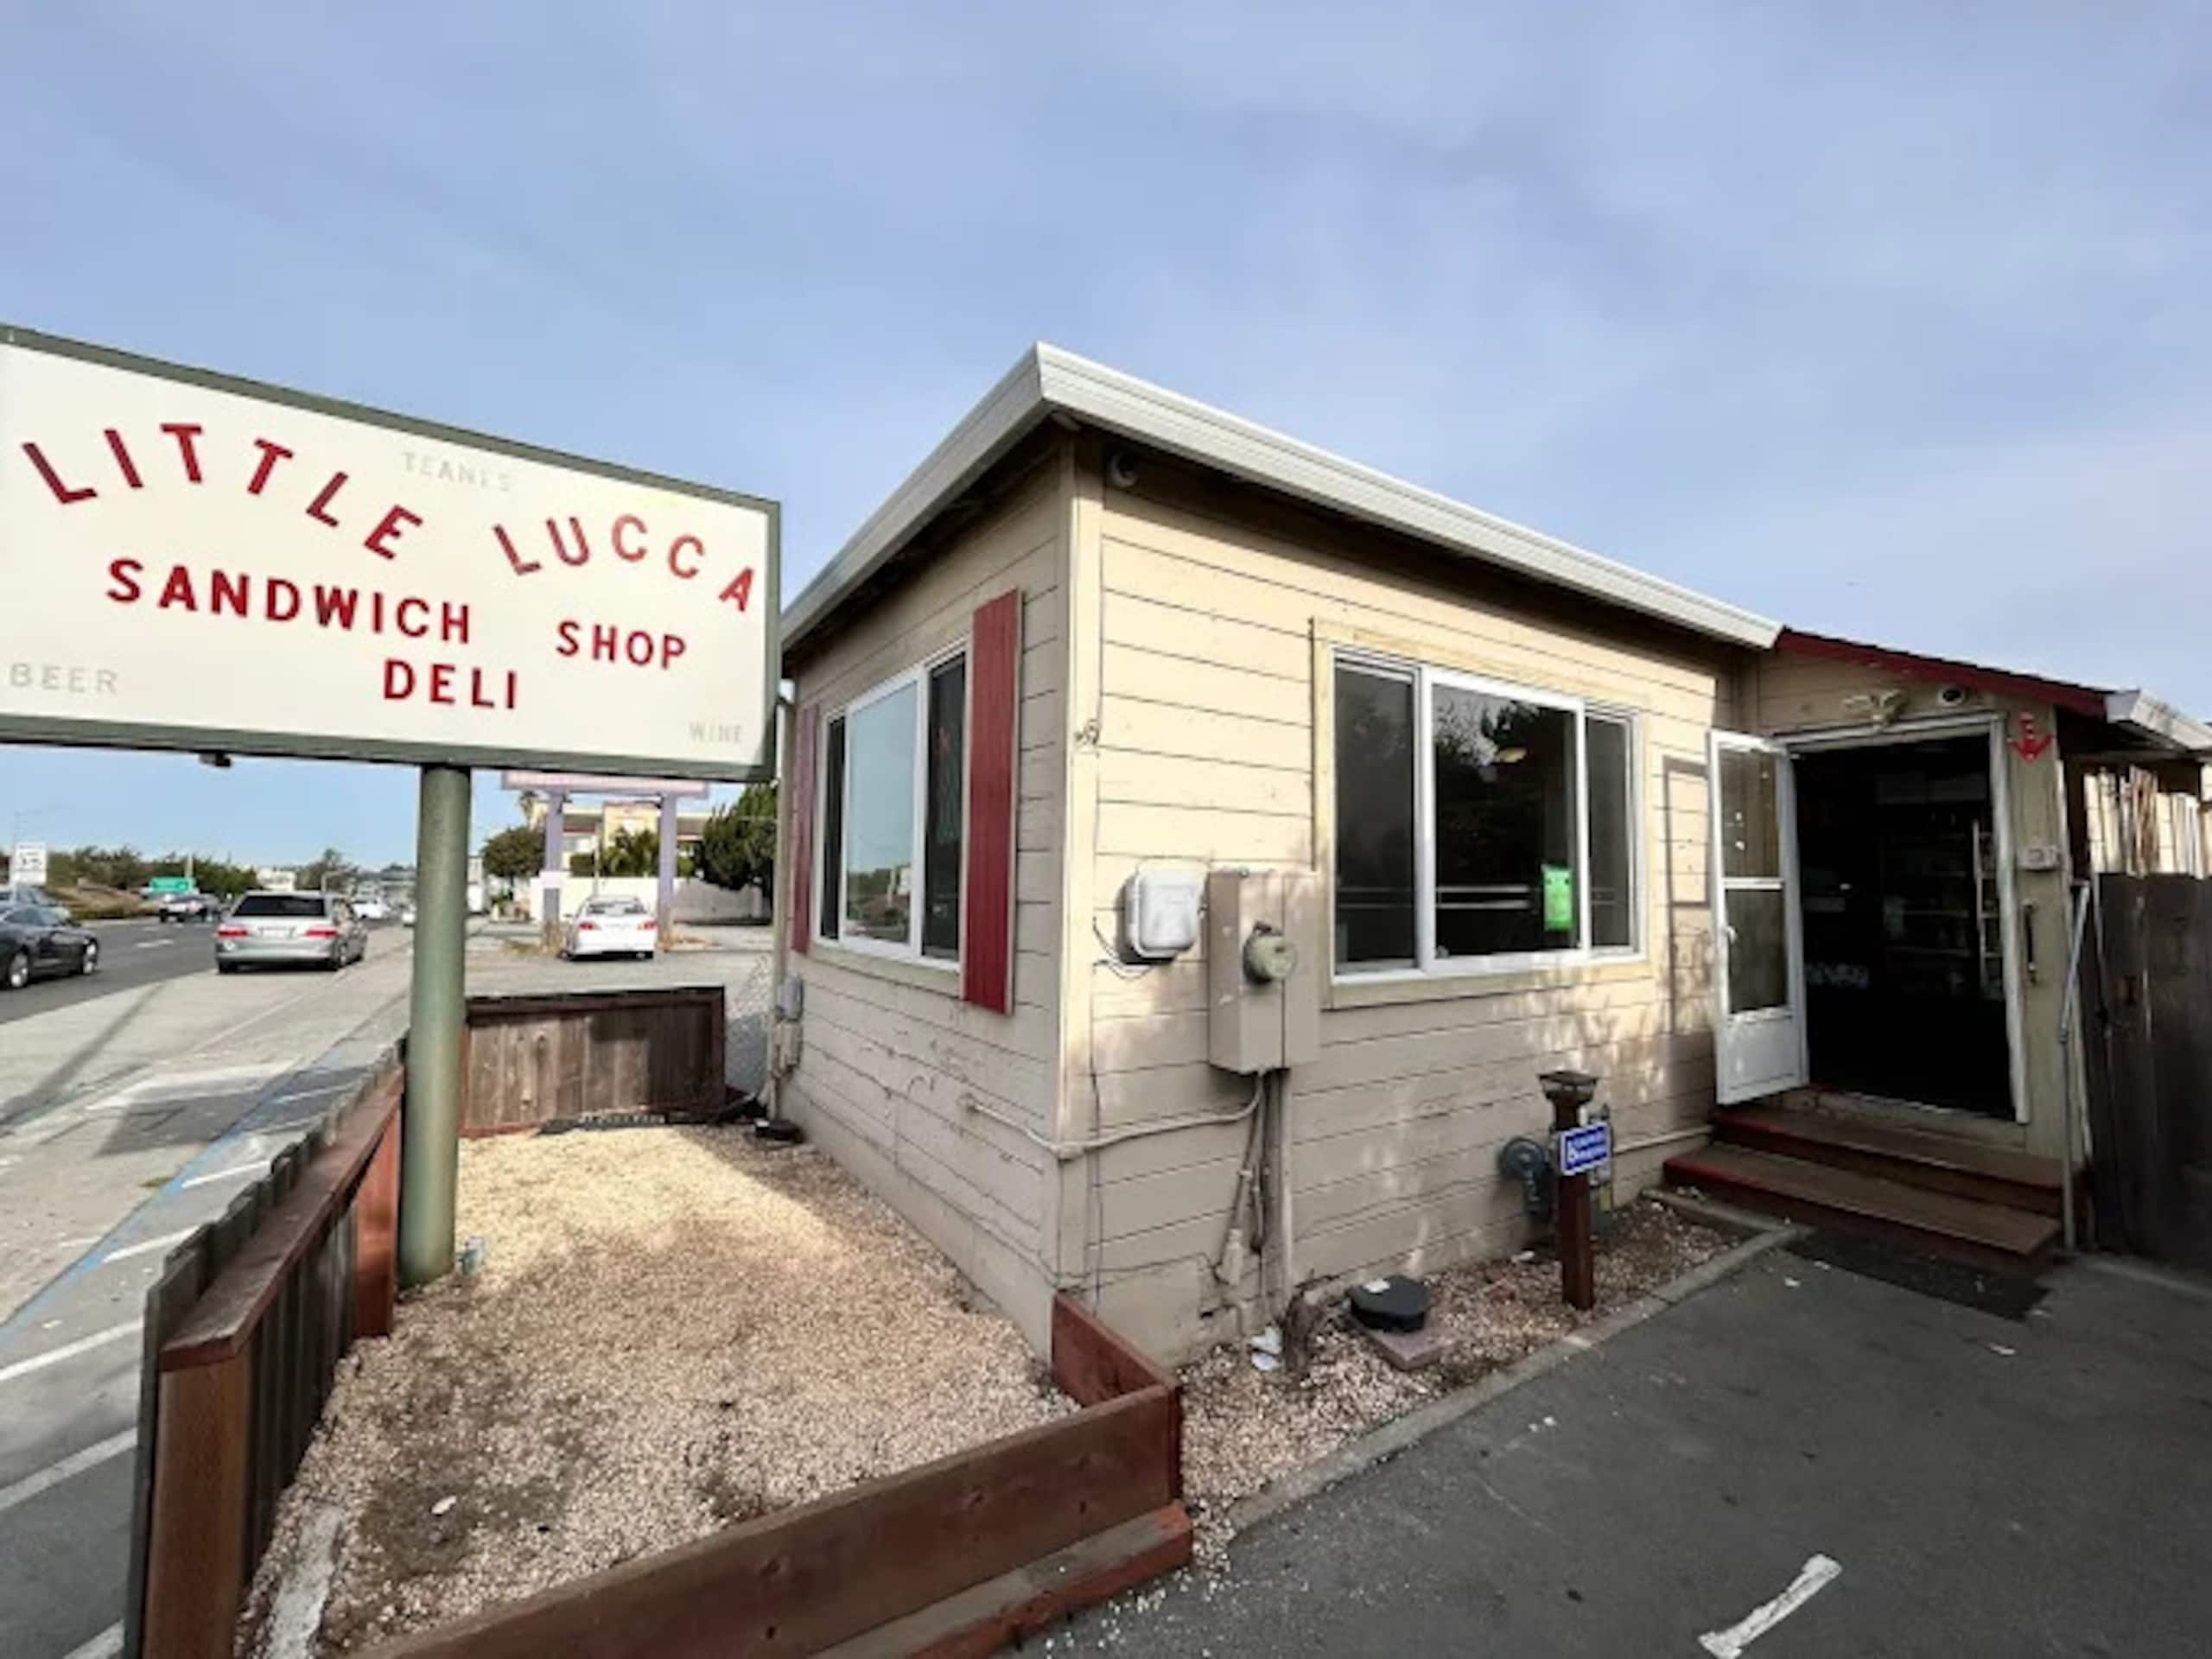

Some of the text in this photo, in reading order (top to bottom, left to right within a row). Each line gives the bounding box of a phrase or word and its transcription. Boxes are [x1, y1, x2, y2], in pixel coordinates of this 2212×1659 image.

[24, 421, 755, 613] LITTLE LUCCA
[105, 556, 686, 671] SANDWICH SHOP
[10, 662, 118, 696] BEER
[381, 656, 518, 709] DELI
